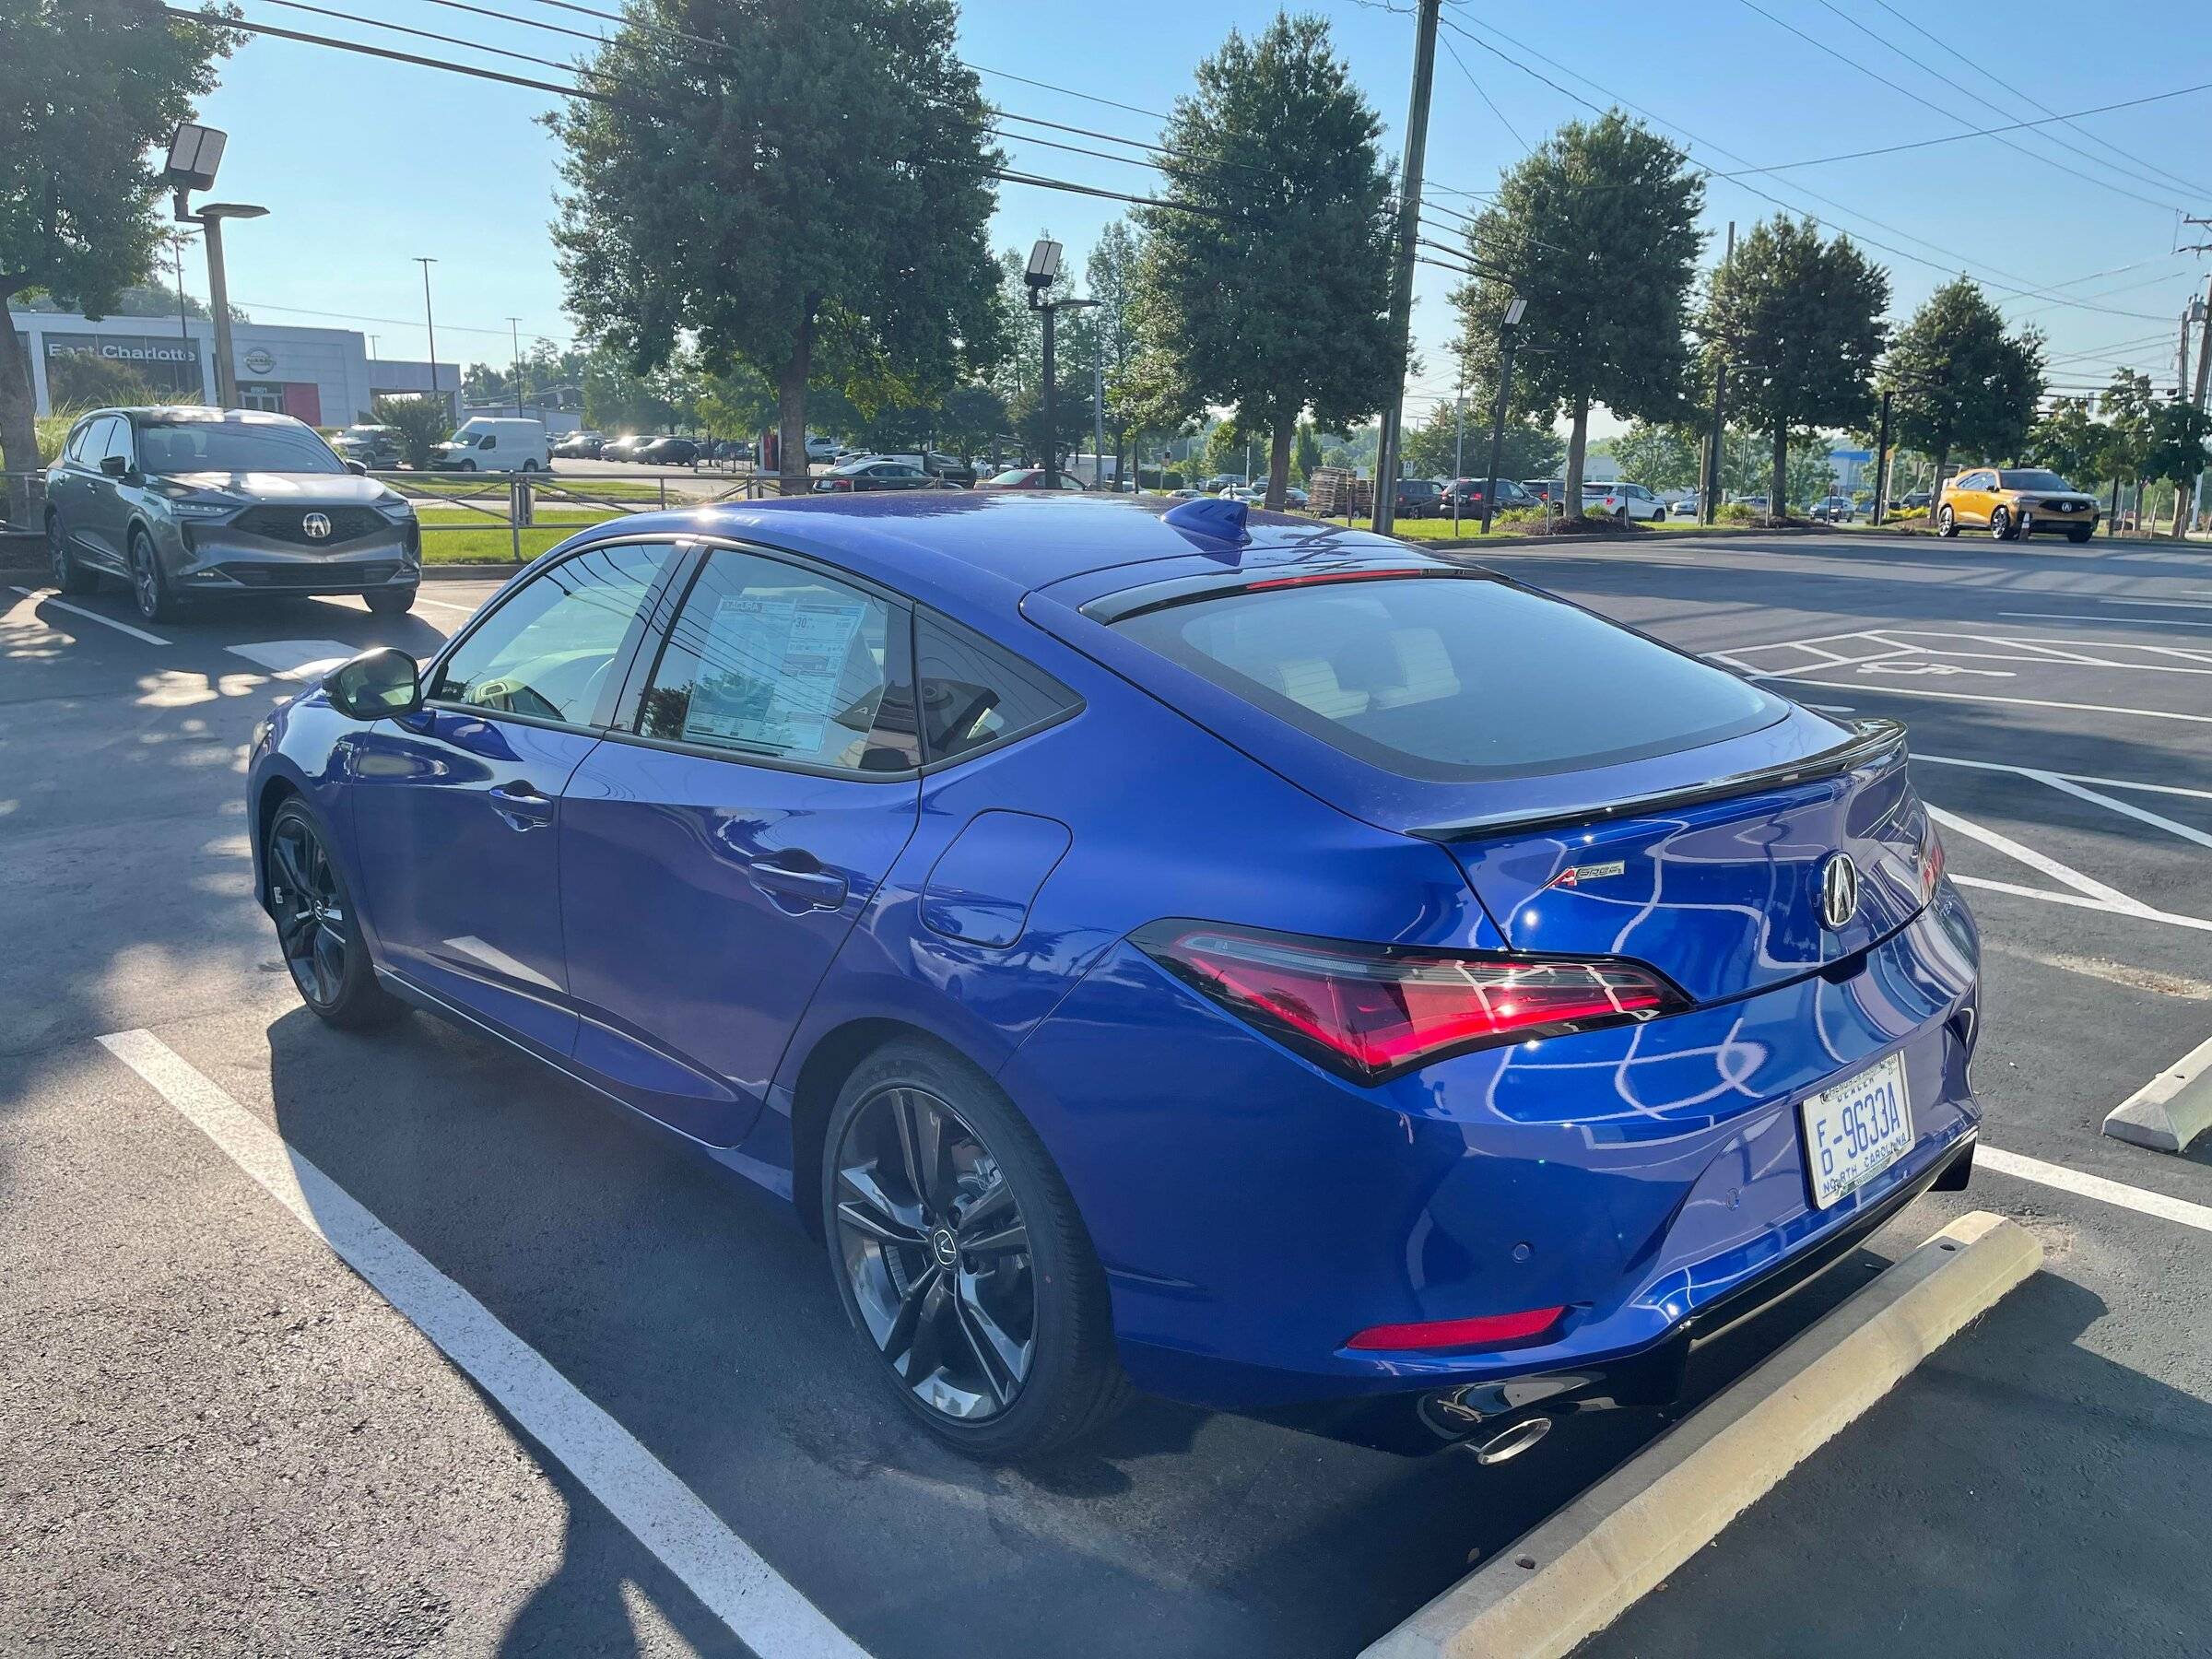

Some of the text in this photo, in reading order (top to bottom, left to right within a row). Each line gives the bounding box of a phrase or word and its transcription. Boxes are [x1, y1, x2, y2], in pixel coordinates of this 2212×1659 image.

[102, 344, 196, 361] Charlotte
[1822, 1164, 1858, 1193] NORTH
[1864, 1132, 1907, 1168] CAROLNA
